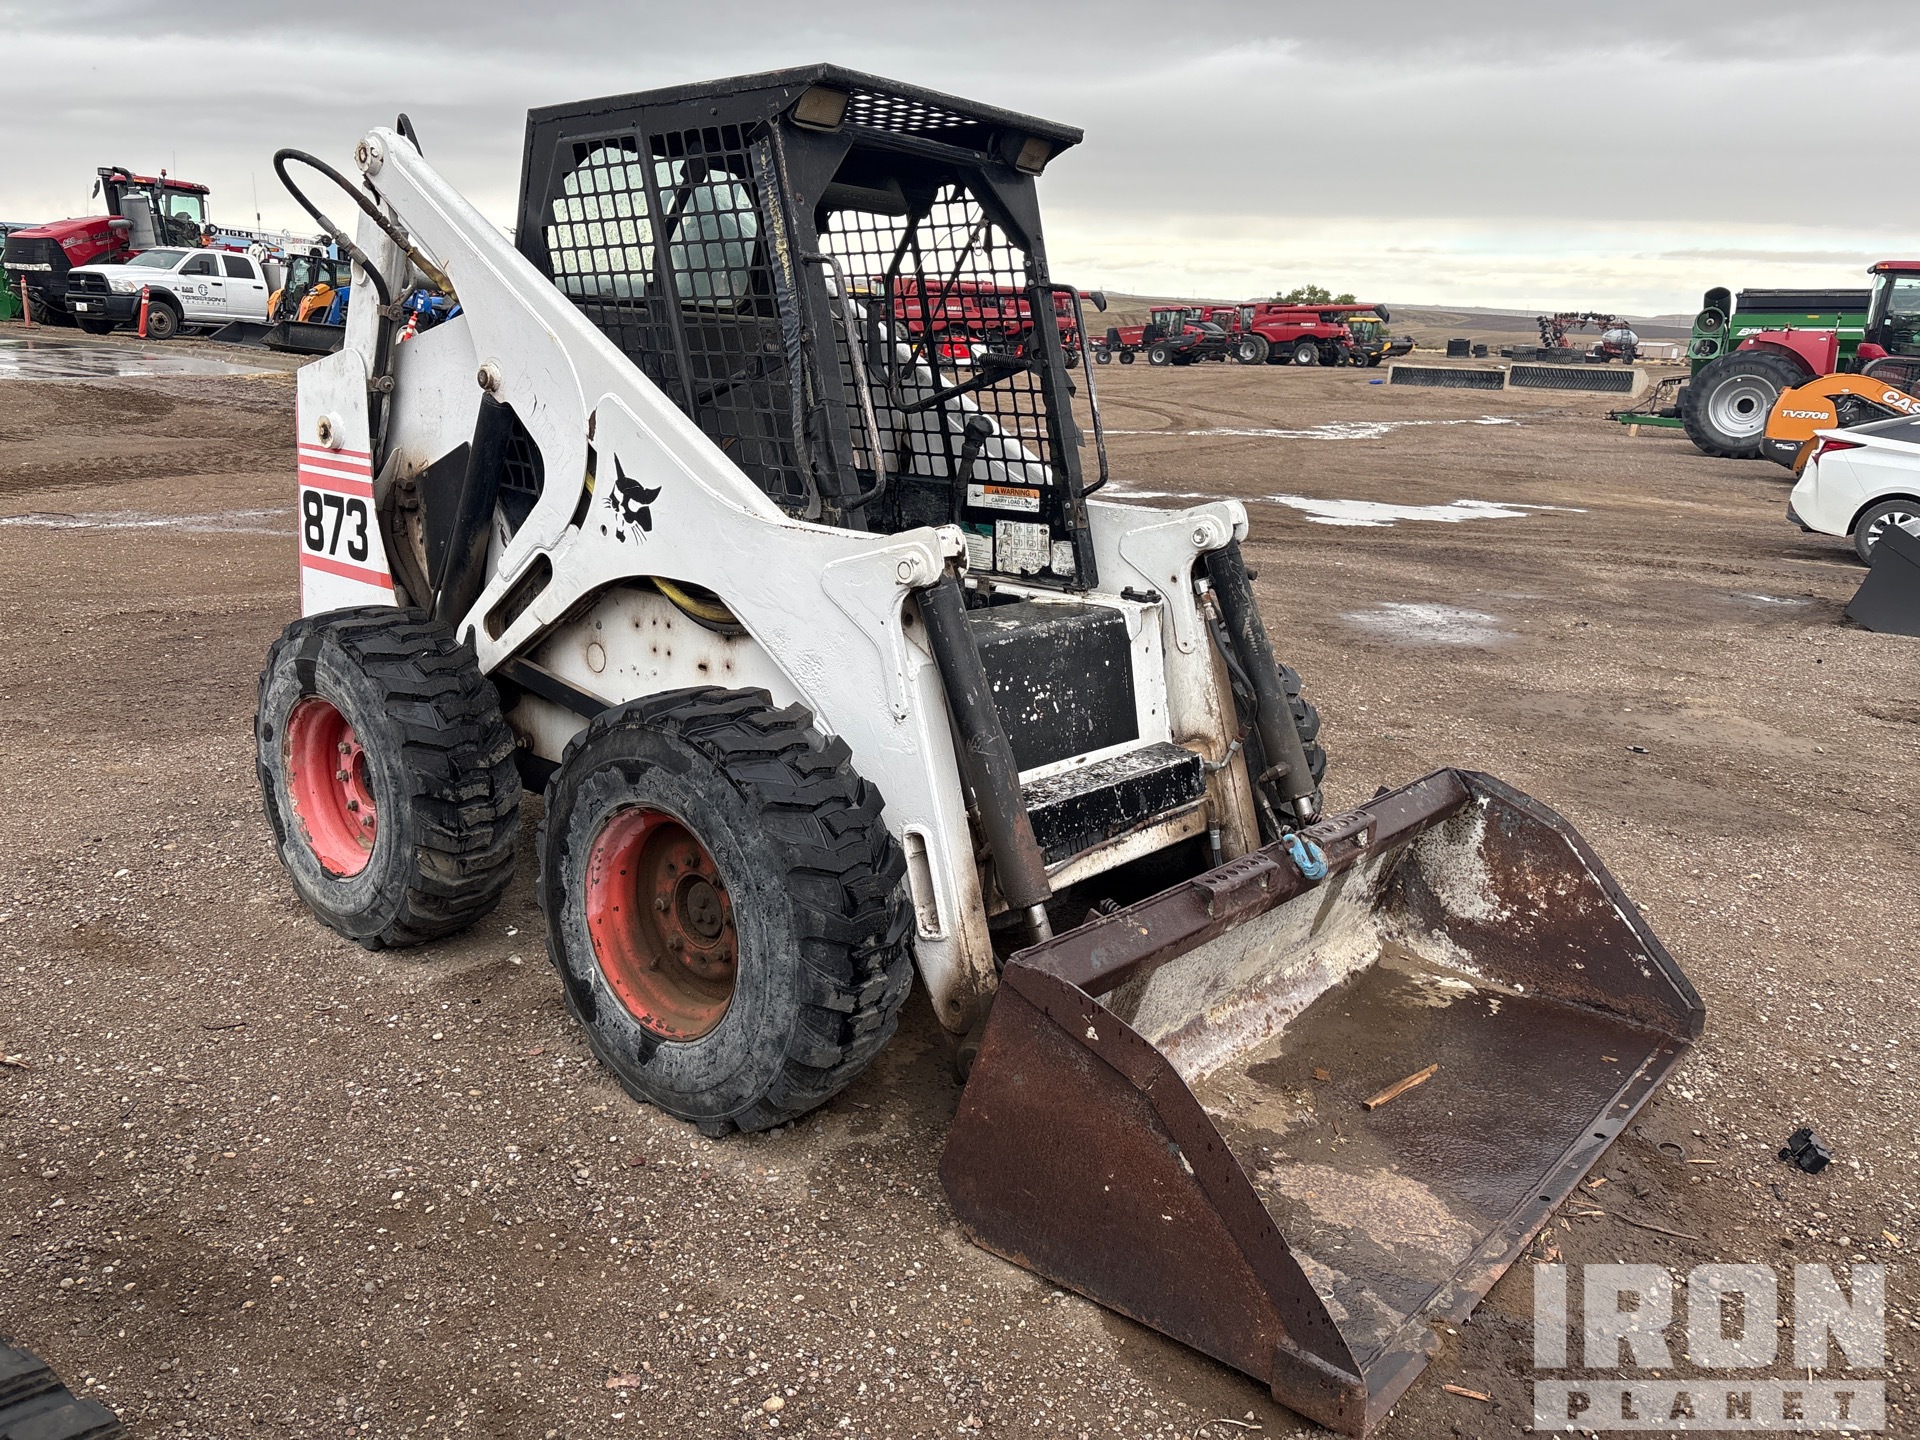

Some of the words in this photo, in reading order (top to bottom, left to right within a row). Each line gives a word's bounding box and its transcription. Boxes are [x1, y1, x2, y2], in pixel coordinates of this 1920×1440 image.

[217, 227, 254, 239] TIGER
[1781, 409, 1830, 421] TV370B
[1000, 488, 1031, 497] WARNING
[303, 489, 369, 562] 873
